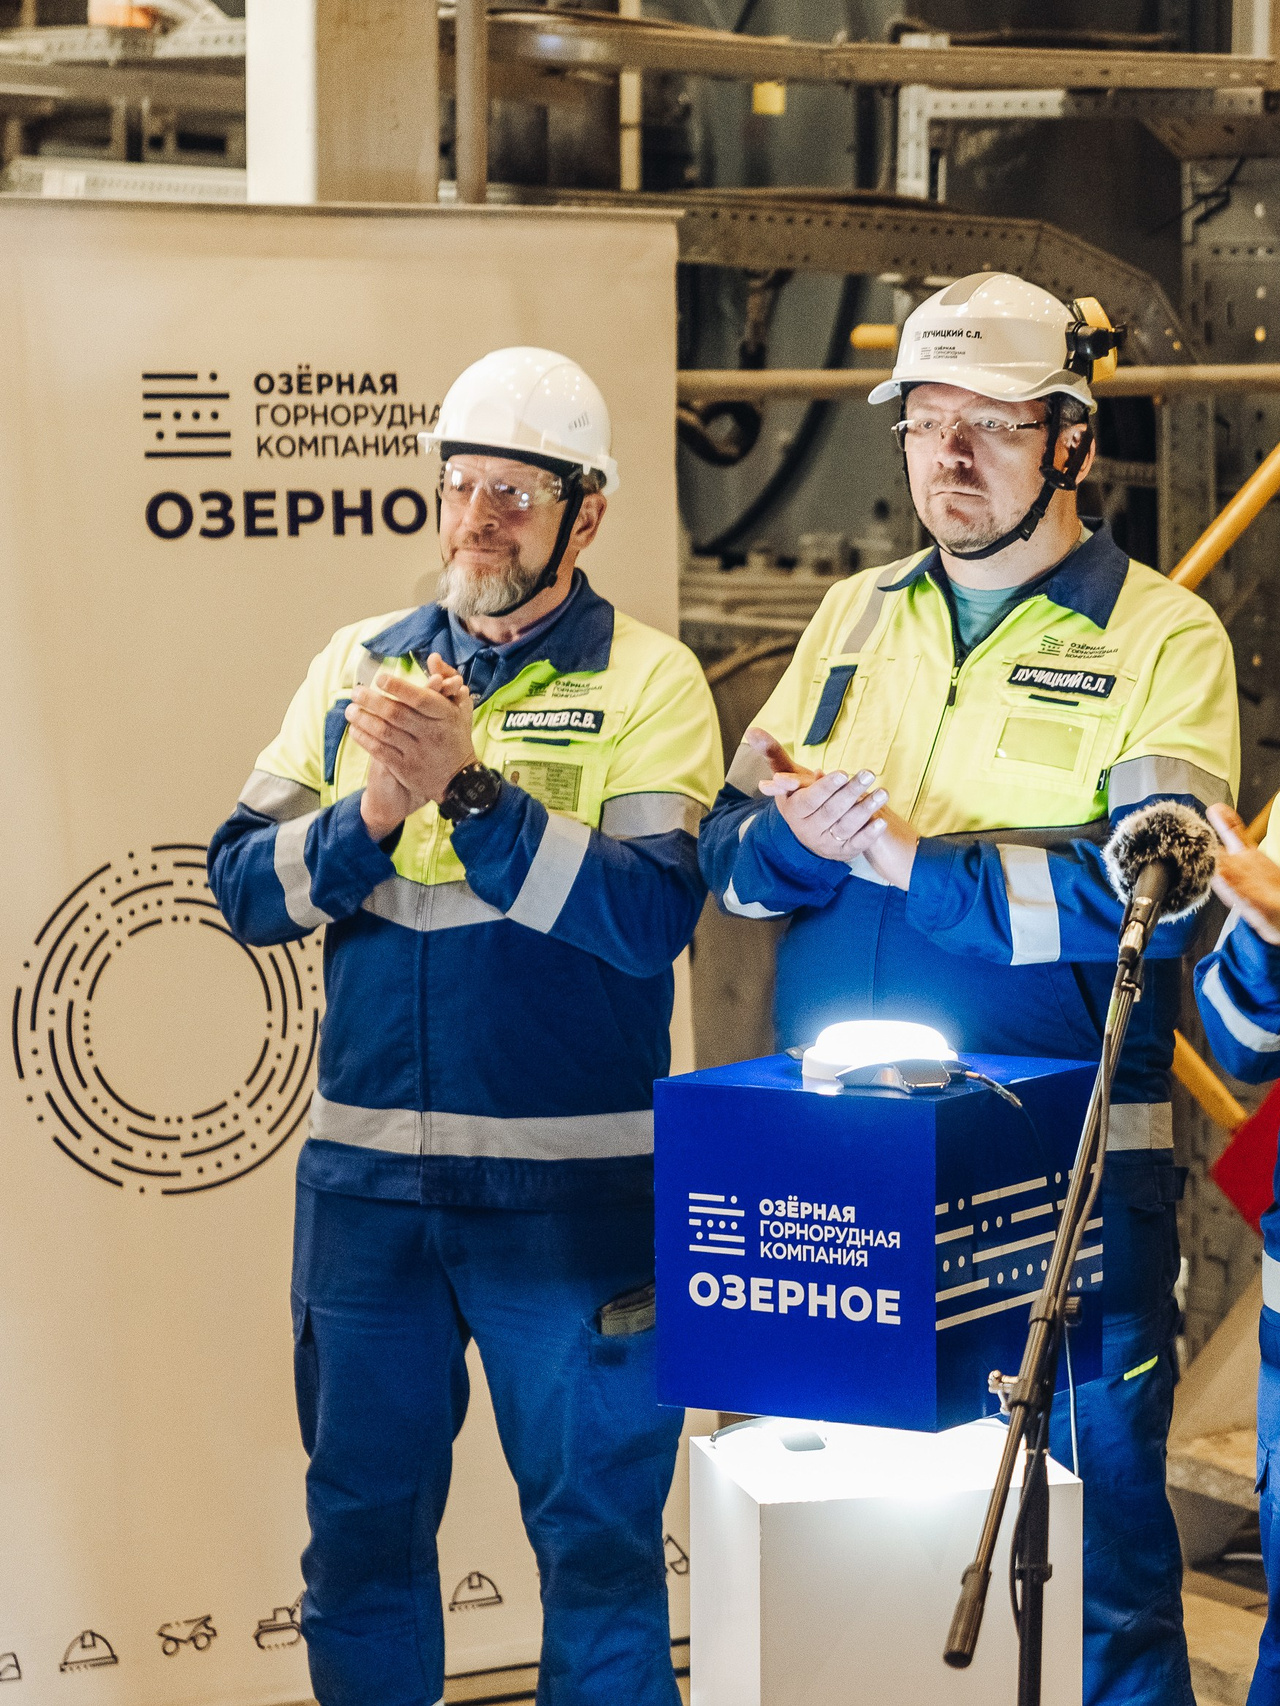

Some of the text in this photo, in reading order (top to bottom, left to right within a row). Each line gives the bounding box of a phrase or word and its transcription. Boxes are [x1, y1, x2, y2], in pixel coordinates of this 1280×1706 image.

[922, 328, 983, 339] ЛУЧИЦКИЙ С.Л.
[253, 363, 398, 395] ОЗЁРНАЯ
[255, 403, 440, 430] ГОРНОРУДНА
[256, 434, 419, 458] КОМПАНИЯ
[145, 487, 441, 540] ОЗЕРНО
[1012, 668, 1084, 688] ЛУЧИЦКИЙ
[505, 711, 596, 729] КОРОЛЕВ С.В.
[759, 1195, 856, 1223] ОЗЁРНАЯ
[760, 1220, 901, 1249] ГОРНОРУДНАЯ
[760, 1241, 869, 1267] КОМПАНИЯ
[688, 1271, 901, 1325] ОЗЕРНОЕ
